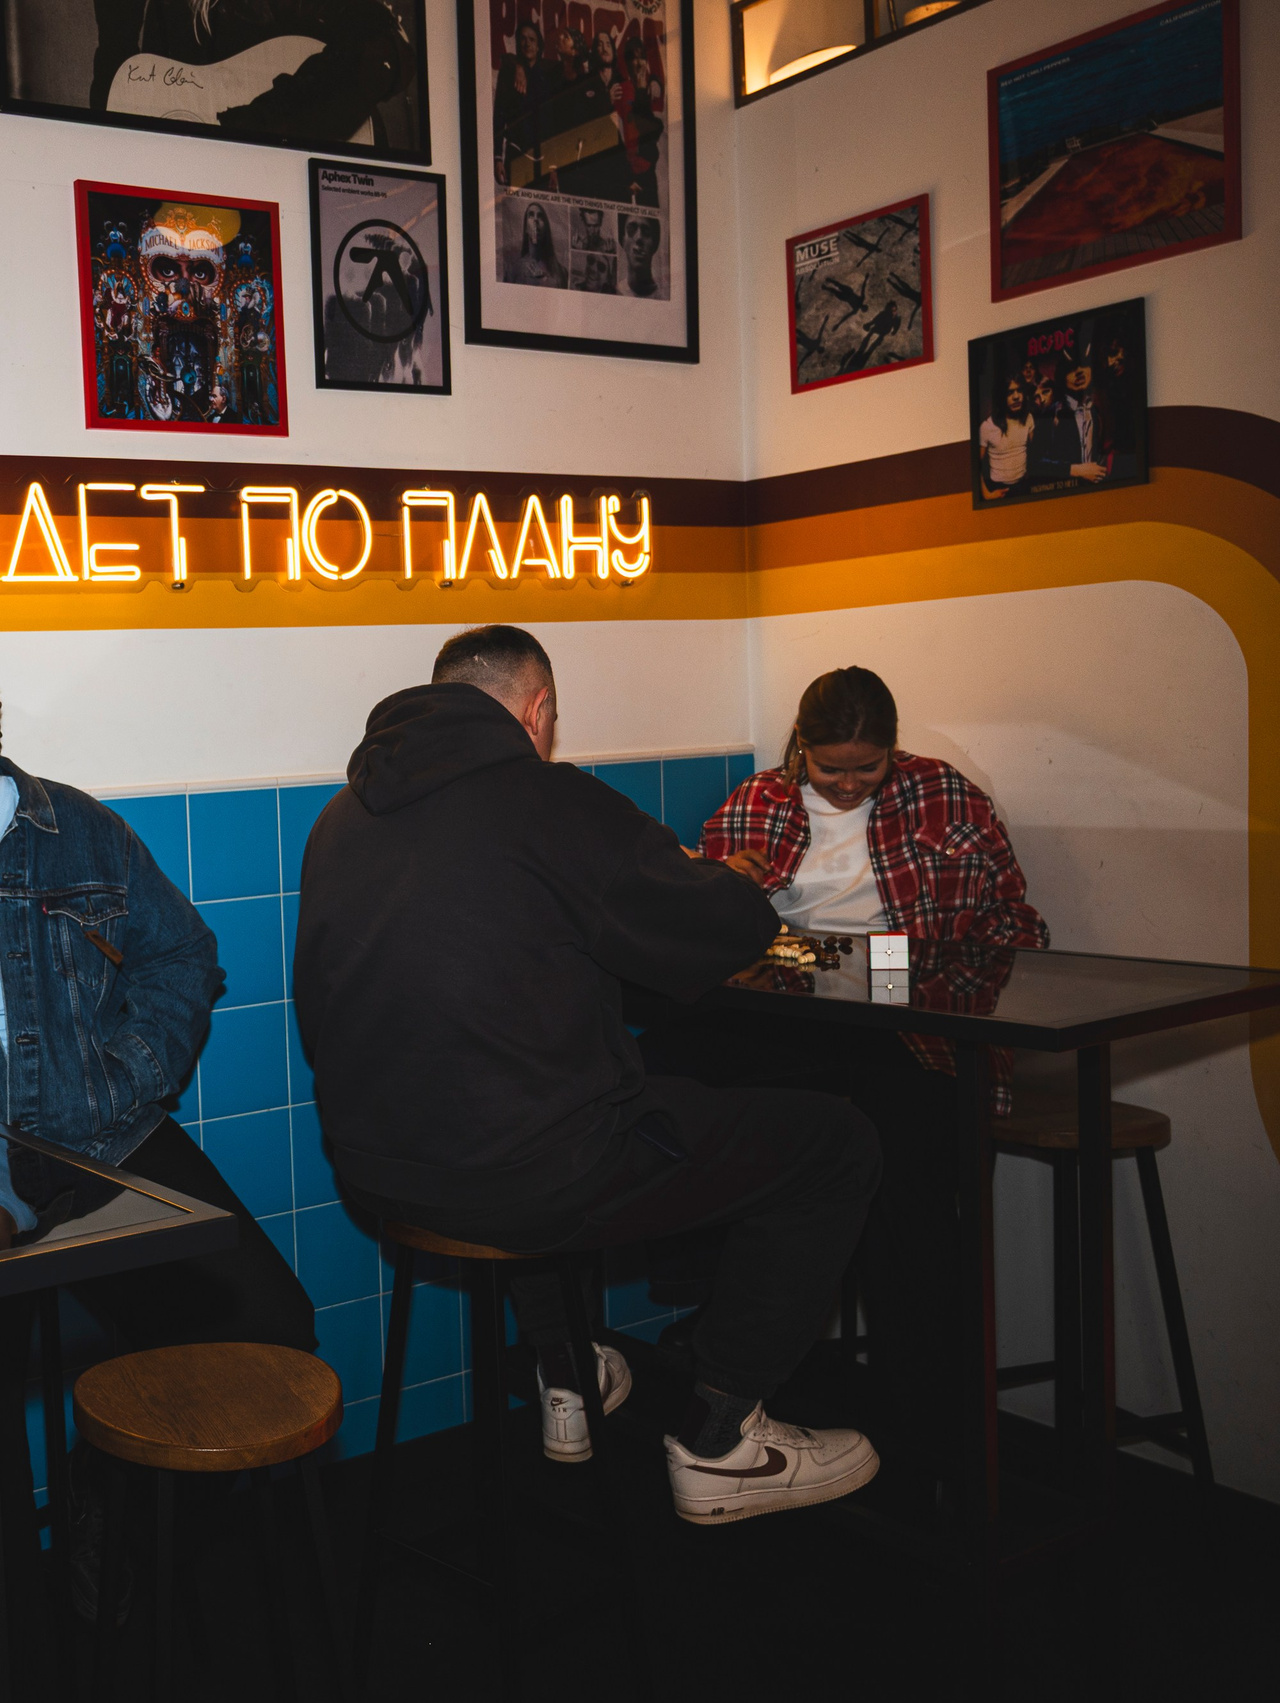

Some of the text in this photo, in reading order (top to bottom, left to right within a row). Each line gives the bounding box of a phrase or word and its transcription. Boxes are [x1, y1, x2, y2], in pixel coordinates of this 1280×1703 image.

[321, 170, 374, 187] Aphex Twin
[145, 233, 220, 257] MICHAEL JACKSON
[795, 238, 838, 263] MUSE
[239, 485, 374, 582] ПО
[402, 488, 652, 581] ПЛАНУ
[711, 1507, 725, 1516] AIR
